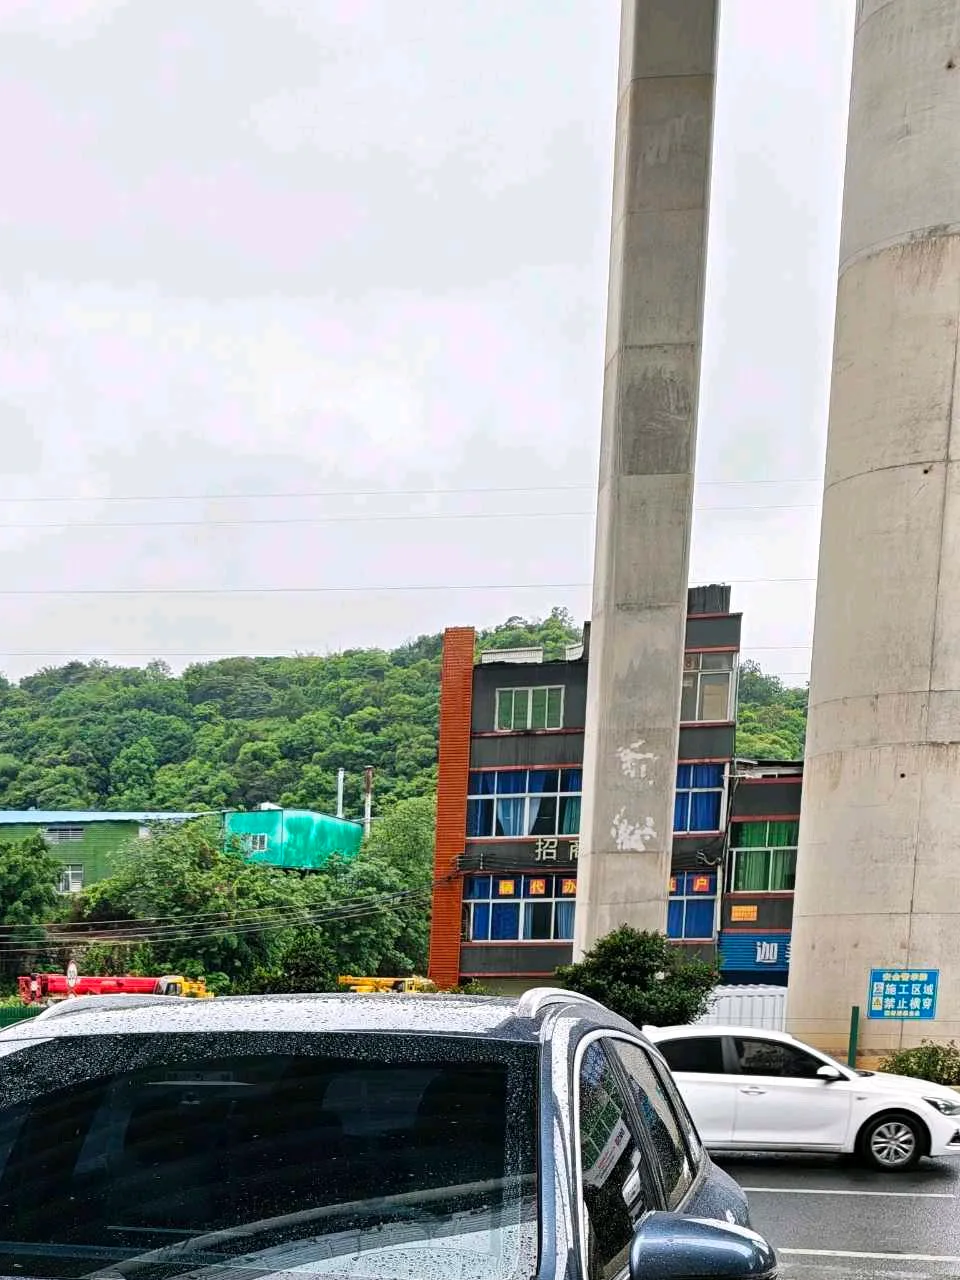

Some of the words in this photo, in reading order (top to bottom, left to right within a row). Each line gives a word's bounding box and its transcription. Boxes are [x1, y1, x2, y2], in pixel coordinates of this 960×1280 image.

[884, 983, 934, 996] 施工区域
[883, 997, 933, 1010] 禁止横穿
